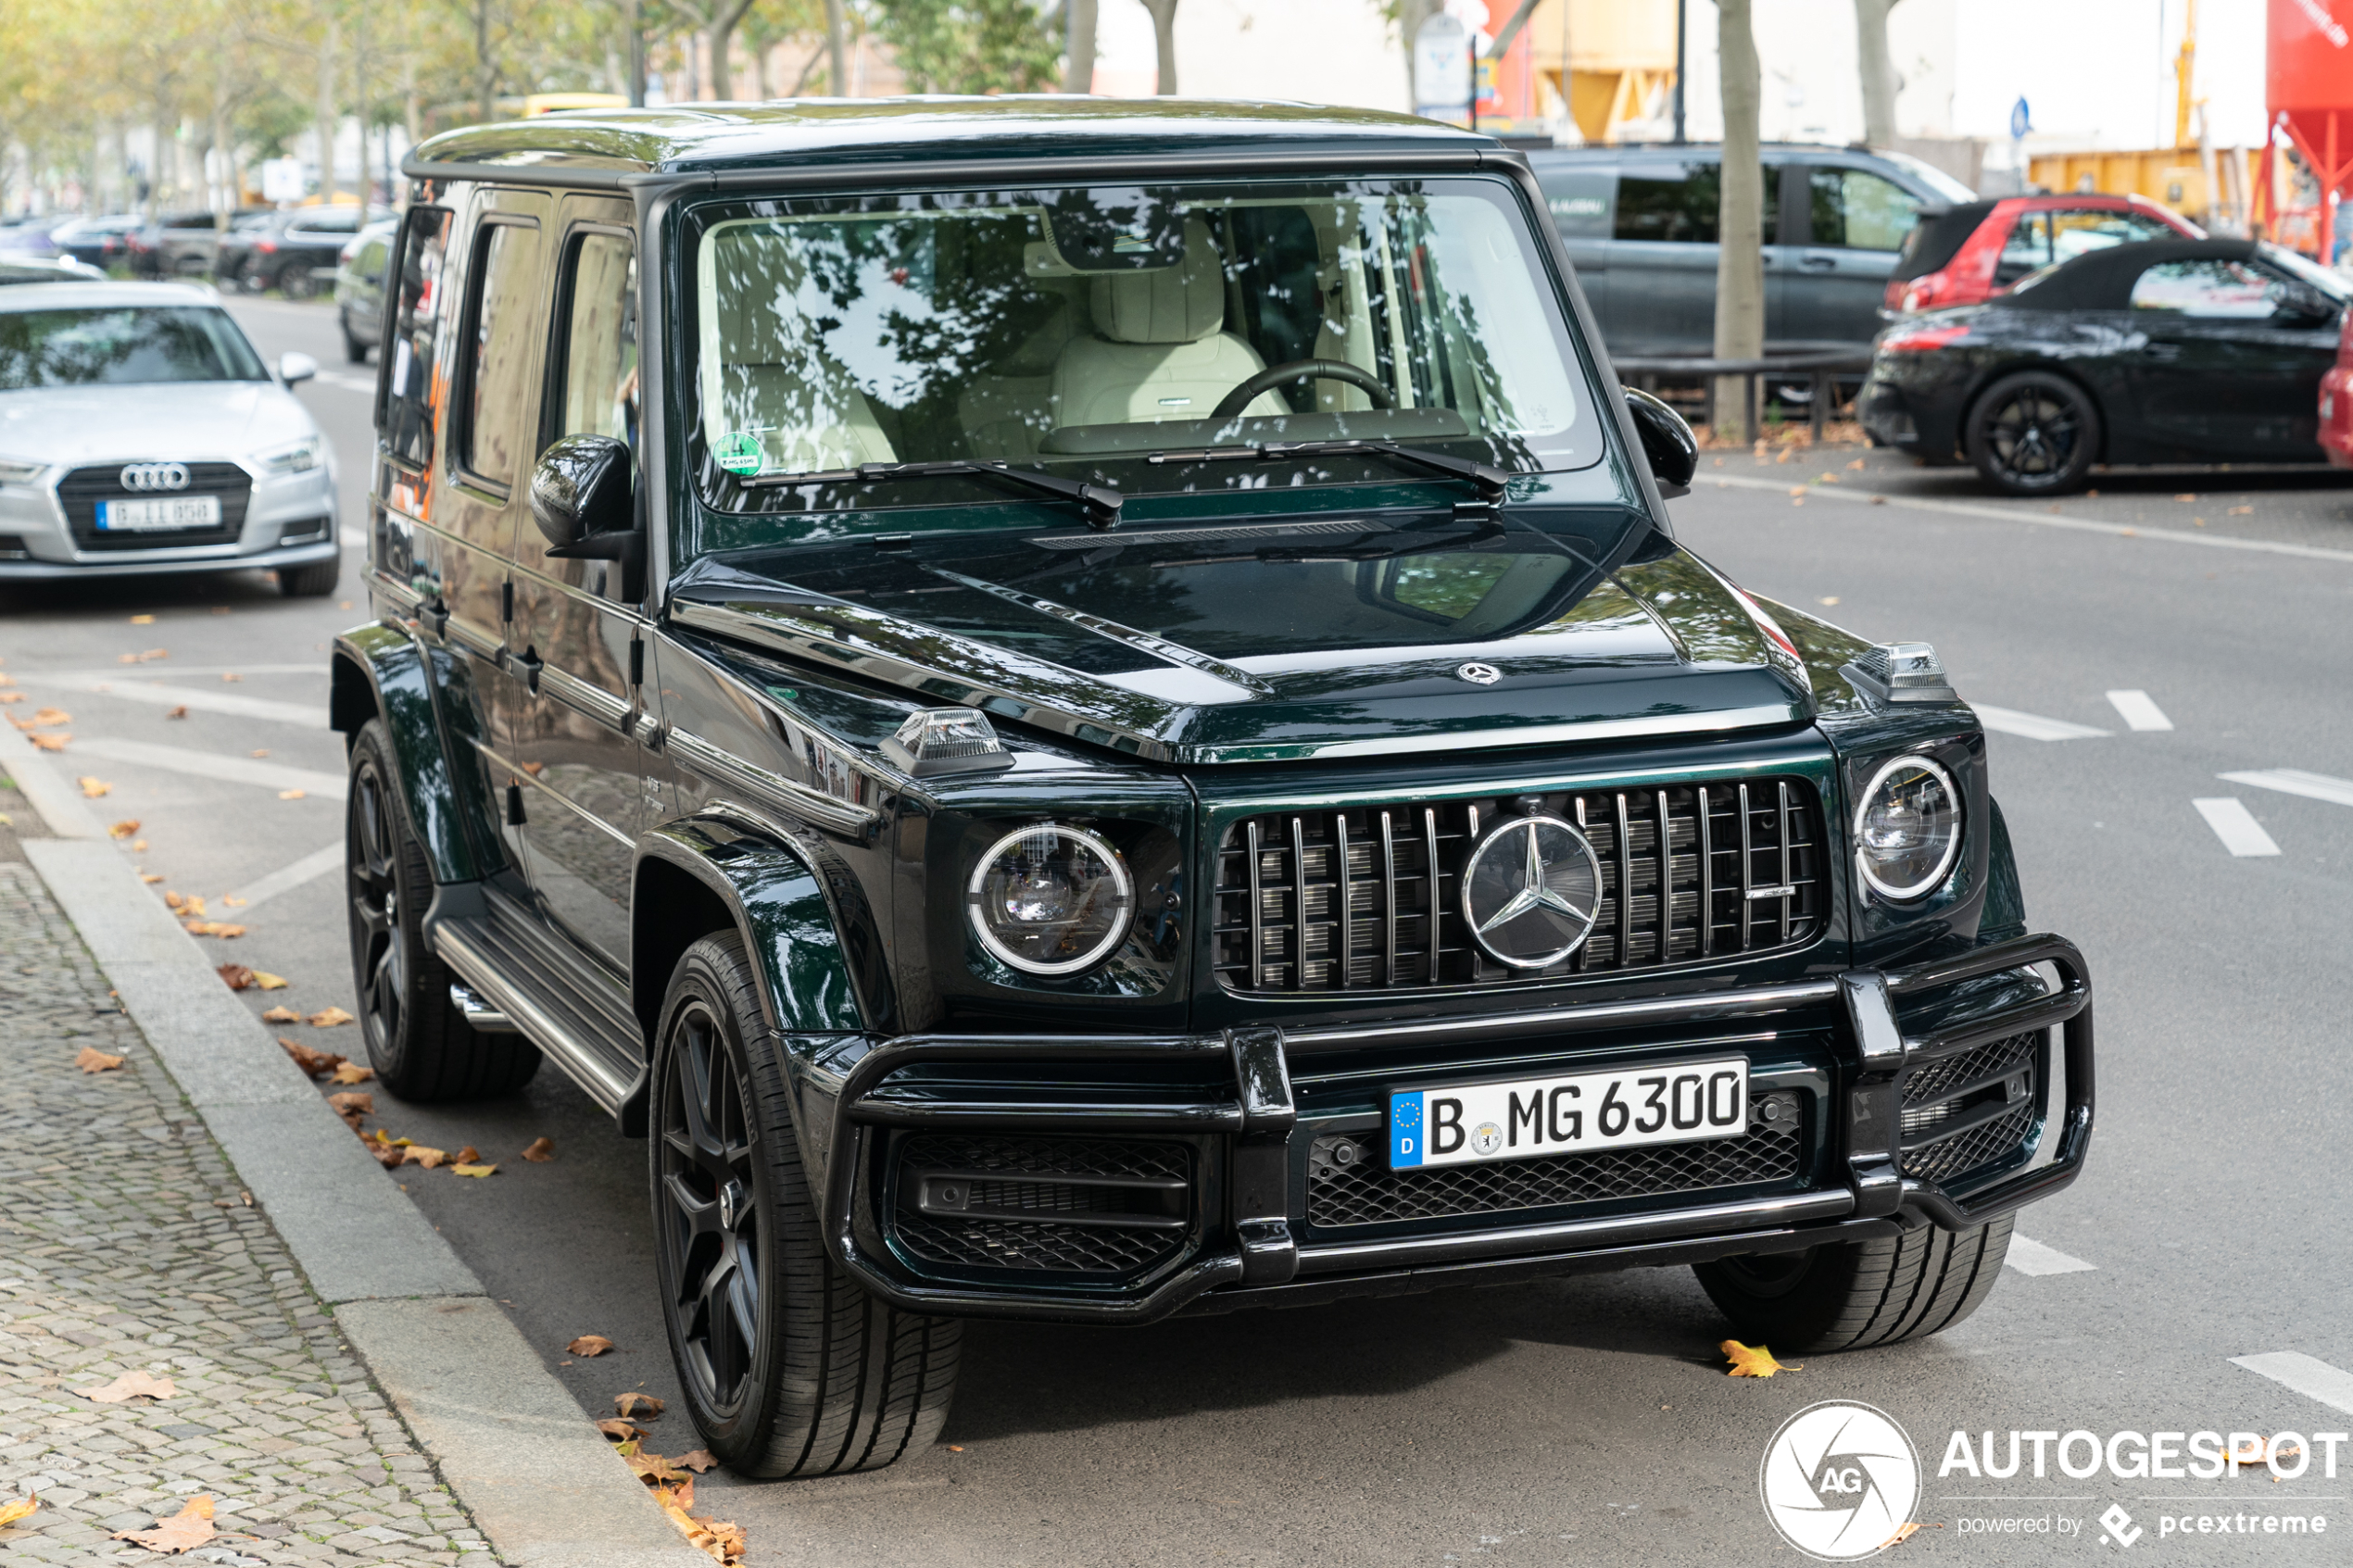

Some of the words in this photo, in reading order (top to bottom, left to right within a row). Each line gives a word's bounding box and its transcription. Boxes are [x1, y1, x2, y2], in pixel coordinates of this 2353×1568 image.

[731, 435, 745, 455] 4
[1430, 1097, 1466, 1156] B
[1508, 1085, 1583, 1148] MG
[1598, 1069, 1741, 1137] 6300
[1401, 1137, 1414, 1155] D
